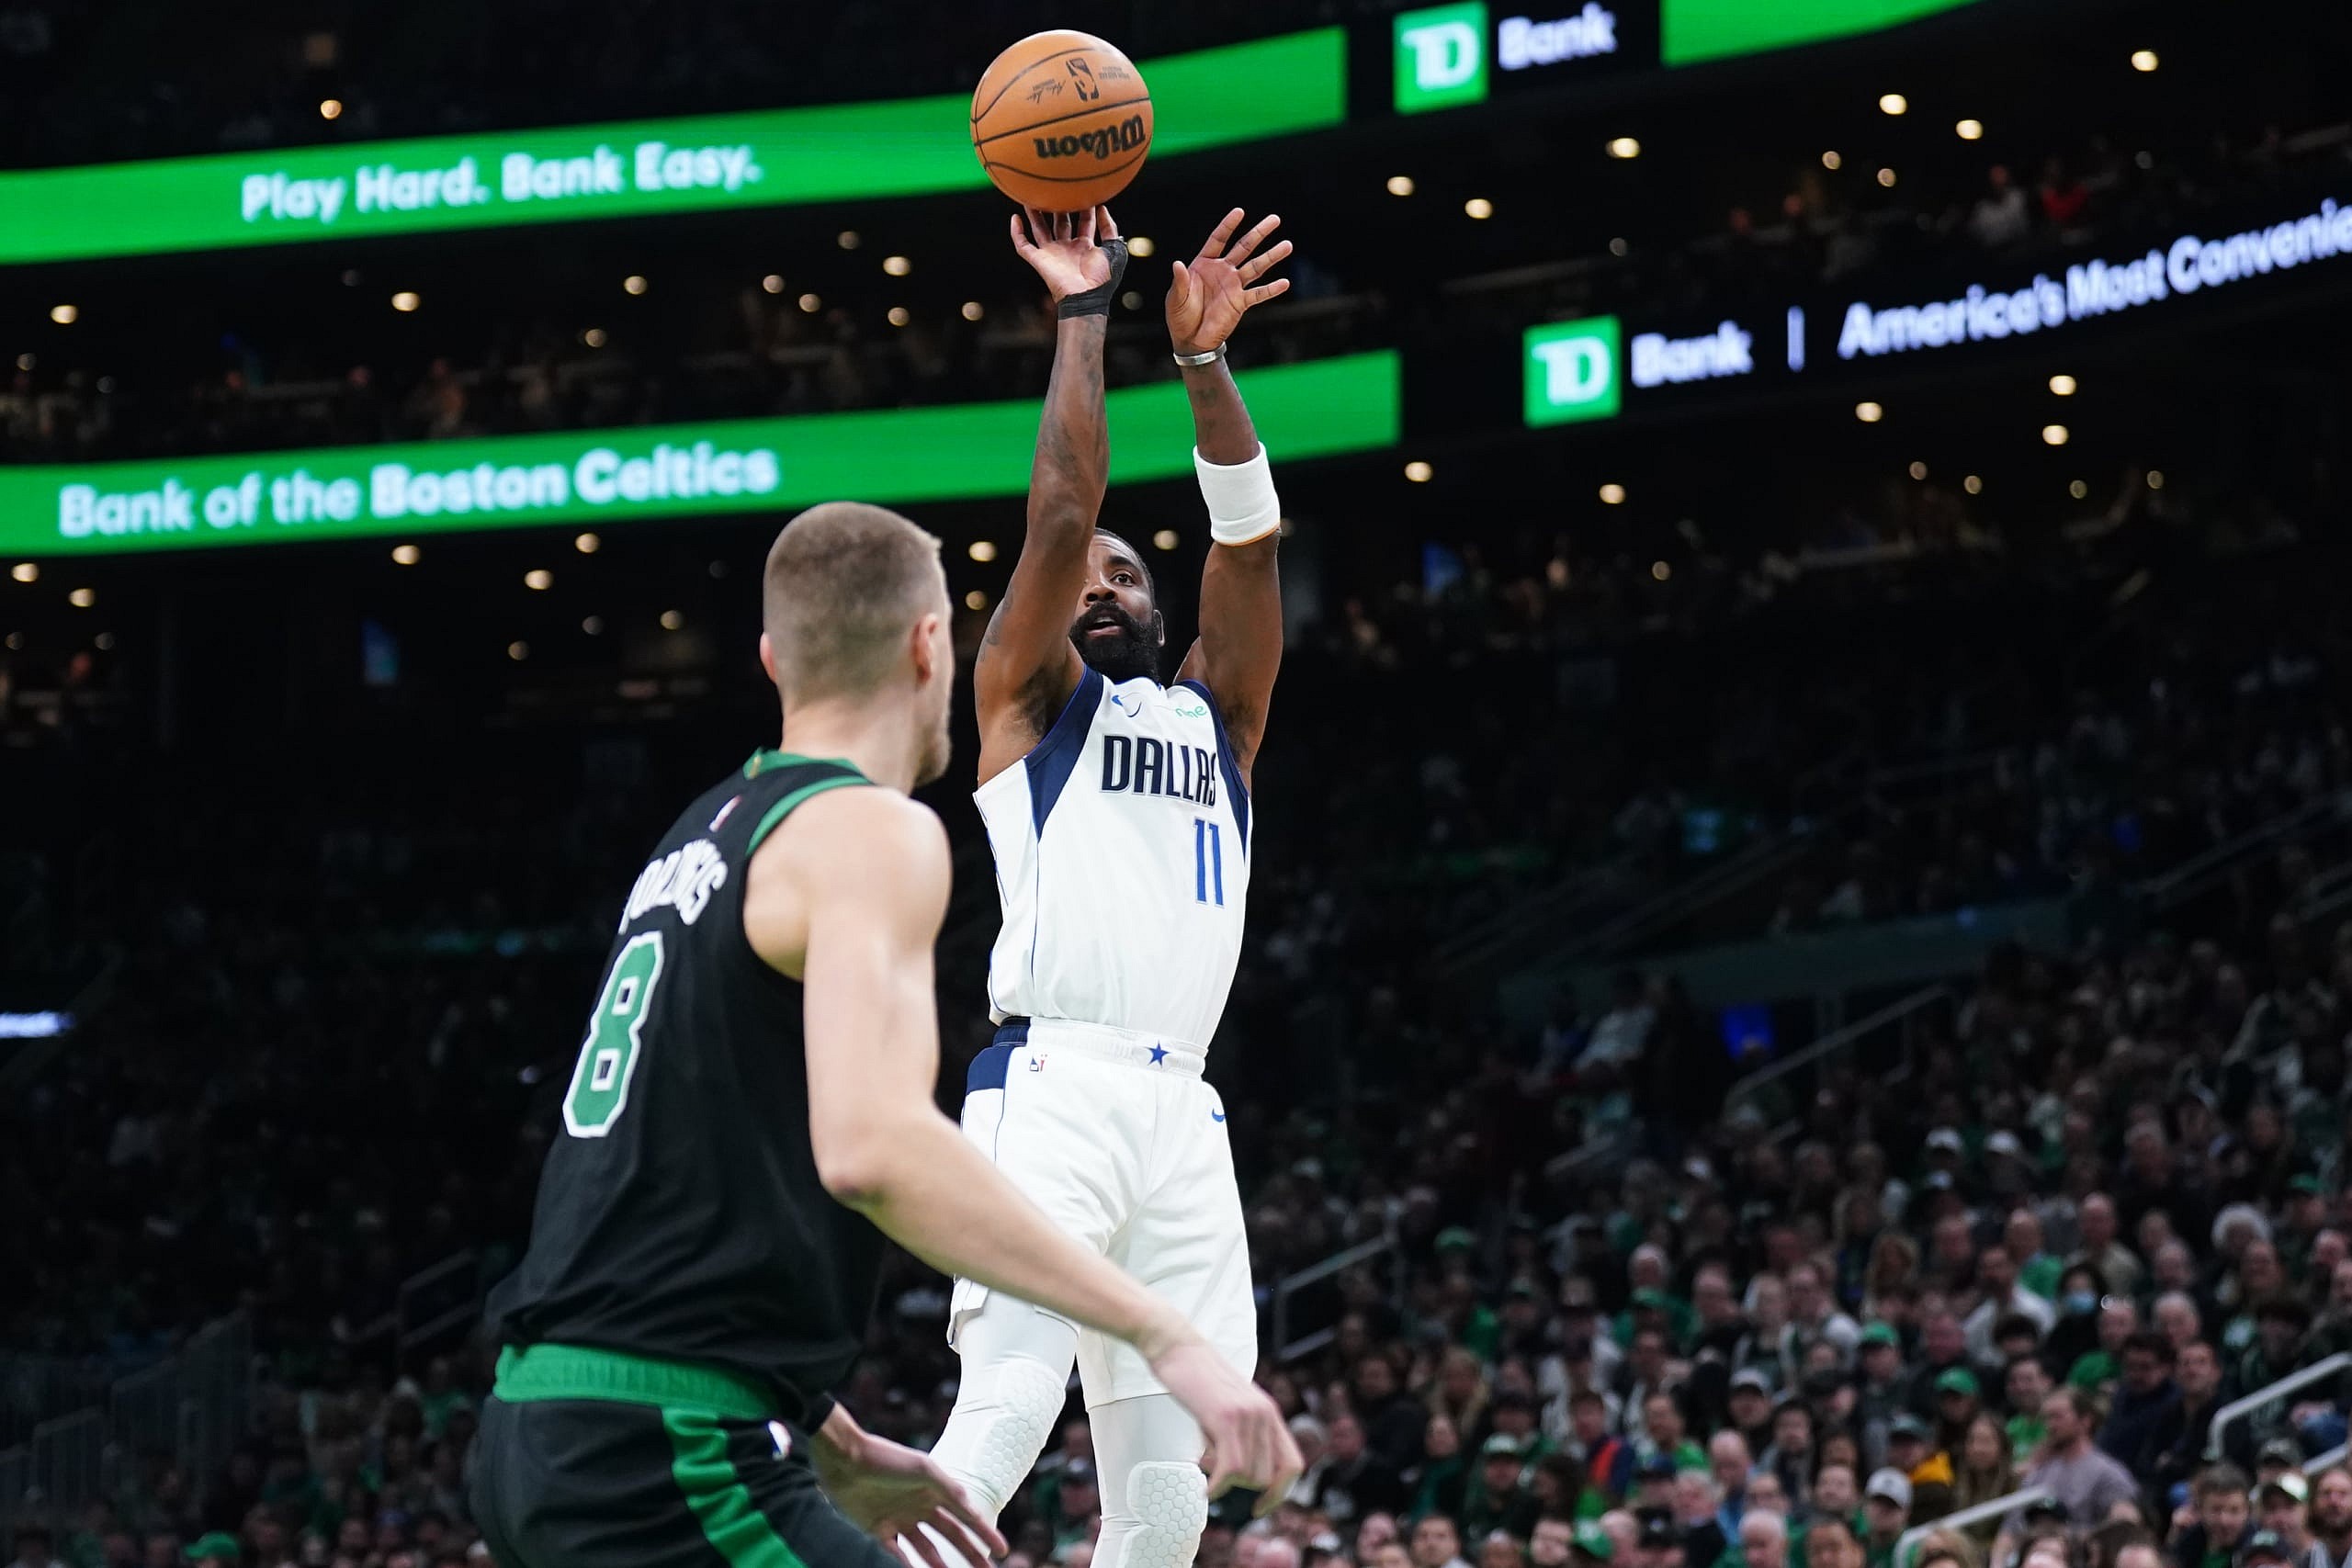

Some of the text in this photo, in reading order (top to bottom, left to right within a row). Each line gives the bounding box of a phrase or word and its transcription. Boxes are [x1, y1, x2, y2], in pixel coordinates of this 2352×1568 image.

[1498, 2, 1617, 70] Bank
[1034, 114, 1147, 160] Wilson
[241, 141, 763, 221] Play Hard. Bank Easy.
[1837, 275, 2065, 359] America's
[2065, 251, 2166, 318] Most
[1630, 321, 1753, 388] Bank
[58, 442, 779, 537] Bank of the Boston Celtics
[1100, 734, 1217, 807] DALLAS
[1193, 817, 1226, 908] 11
[562, 931, 663, 1139] 8
